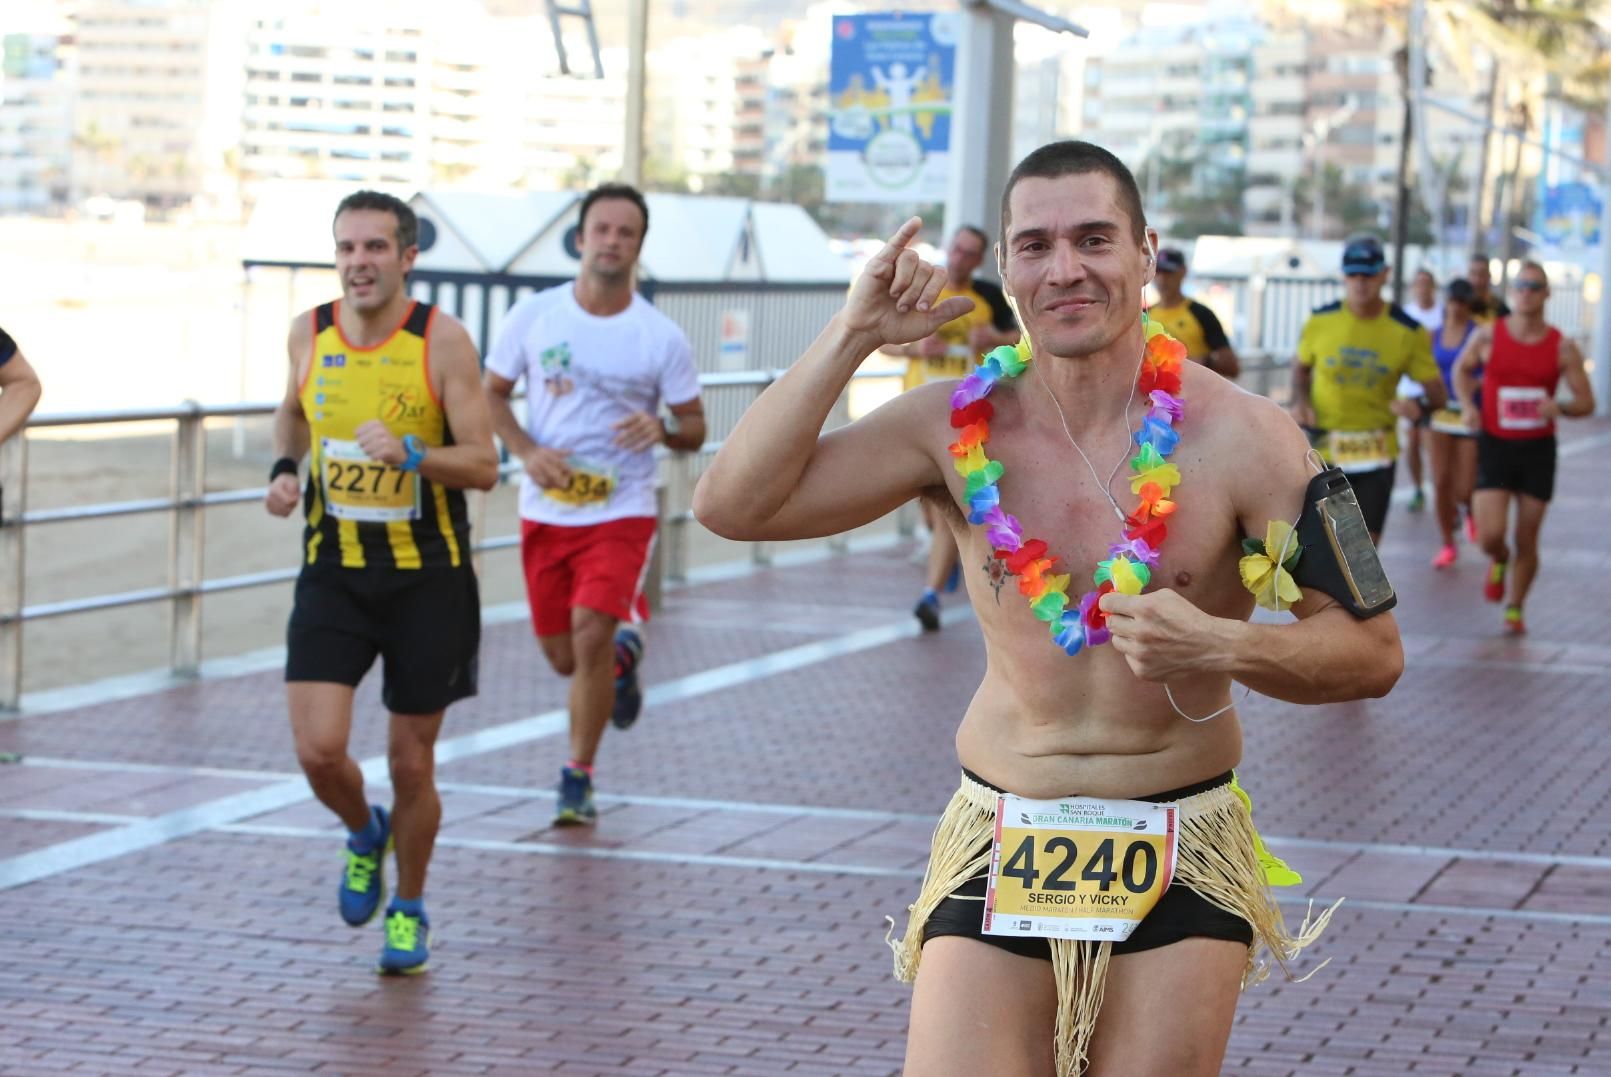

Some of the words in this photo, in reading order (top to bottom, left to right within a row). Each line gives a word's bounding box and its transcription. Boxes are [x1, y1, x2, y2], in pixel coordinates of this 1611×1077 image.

[328, 461, 407, 495] 2277
[1032, 815, 1055, 824] GRAN
[1057, 816, 1094, 825] CANARIA
[1002, 835, 1157, 893] 4240
[1028, 893, 1076, 905] SERGIO
[1080, 894, 1087, 905] Y
[1090, 894, 1129, 906] VICKY
[1096, 907, 1134, 915] MARATHON
